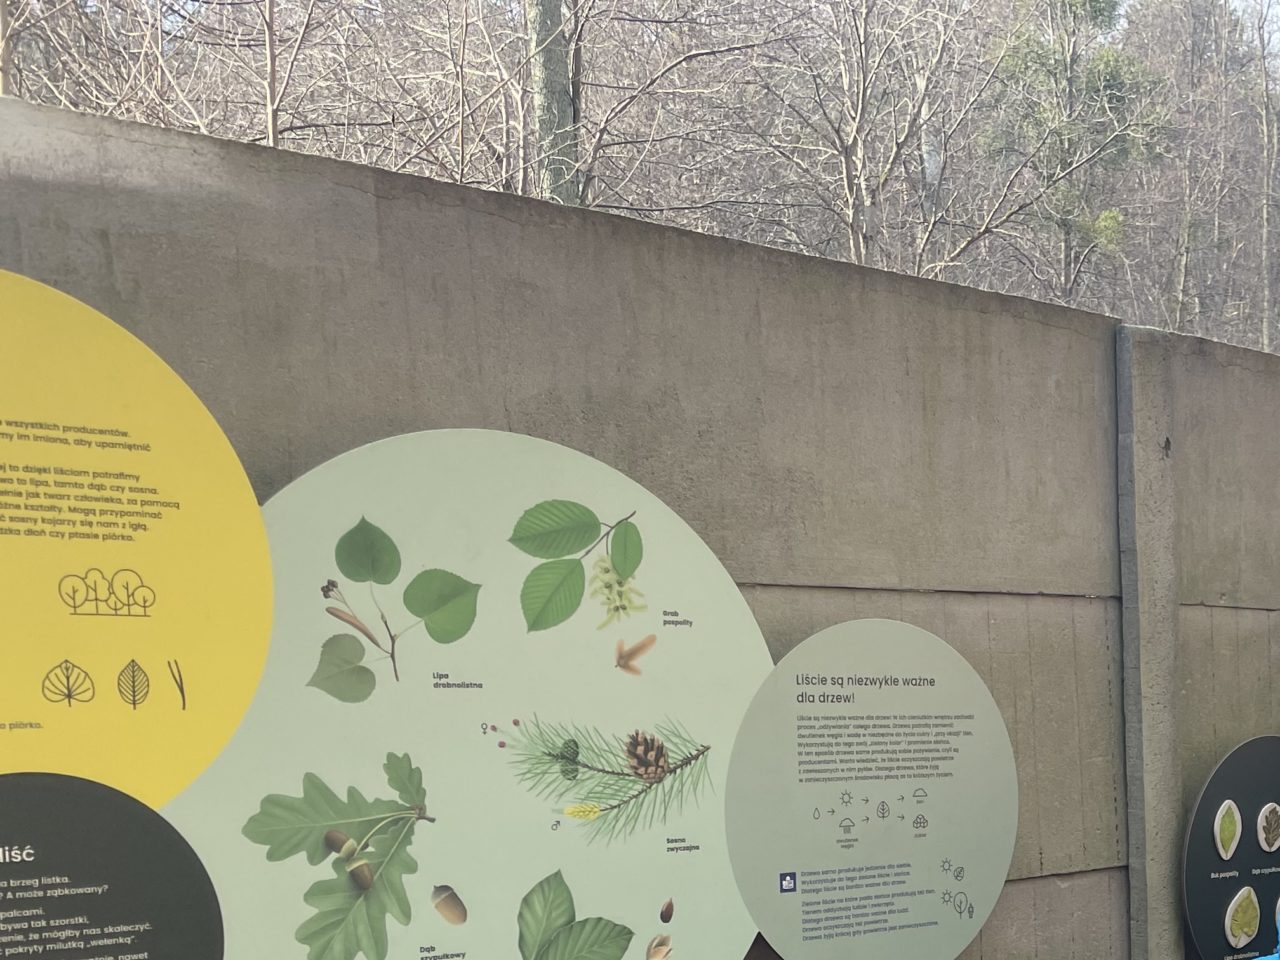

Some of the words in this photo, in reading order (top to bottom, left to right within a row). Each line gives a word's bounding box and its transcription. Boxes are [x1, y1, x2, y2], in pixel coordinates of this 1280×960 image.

[62, 424, 130, 437] producentów.
[17, 431, 31, 441] im
[32, 432, 71, 445] imiona,
[73, 436, 92, 449] aby
[95, 440, 151, 452] upamiętnić
[8, 462, 20, 472] to
[22, 463, 52, 476] dzięki
[53, 466, 90, 477] liściom
[92, 469, 140, 483] potrafimy
[16, 476, 27, 486] to
[53, 479, 85, 490] tamto
[87, 482, 107, 494] dąb
[109, 486, 126, 496] czy
[25, 489, 41, 500] jak
[43, 490, 71, 501] twarz
[73, 493, 125, 505] człowieka,
[140, 499, 180, 510] pomocą
[24, 502, 64, 515] kształty.
[68, 505, 97, 518] Mogą
[98, 509, 163, 520] przypominać
[8, 516, 38, 526] sosny
[41, 515, 77, 528] kojarzy
[79, 518, 94, 529] się
[128, 520, 149, 532] igłą.
[23, 527, 46, 537] dłoń
[49, 531, 66, 540] czy
[68, 530, 100, 541] ptasie
[102, 532, 135, 543] piórko.
[663, 619, 692, 627] pospolity
[433, 672, 449, 680] Lipa
[796, 674, 827, 686] Liście
[830, 676, 843, 688] są
[847, 674, 899, 689] niezwykle
[902, 676, 935, 687] ważne
[797, 692, 815, 703] dla
[818, 692, 855, 703] drzew!
[667, 845, 700, 853] zwyczajna
[10, 878, 39, 888] brzeg
[41, 875, 70, 885] listka.
[6, 889, 13, 899] A
[16, 888, 44, 898] może
[46, 883, 108, 898] ząbkowany?
[31, 918, 47, 928] tak
[50, 916, 90, 926] szorstki,
[28, 931, 40, 940] że
[42, 928, 80, 940] mógłby
[104, 922, 152, 934] skaleczyć.
[5, 942, 44, 956] pokryty
[46, 939, 84, 951] milutką
